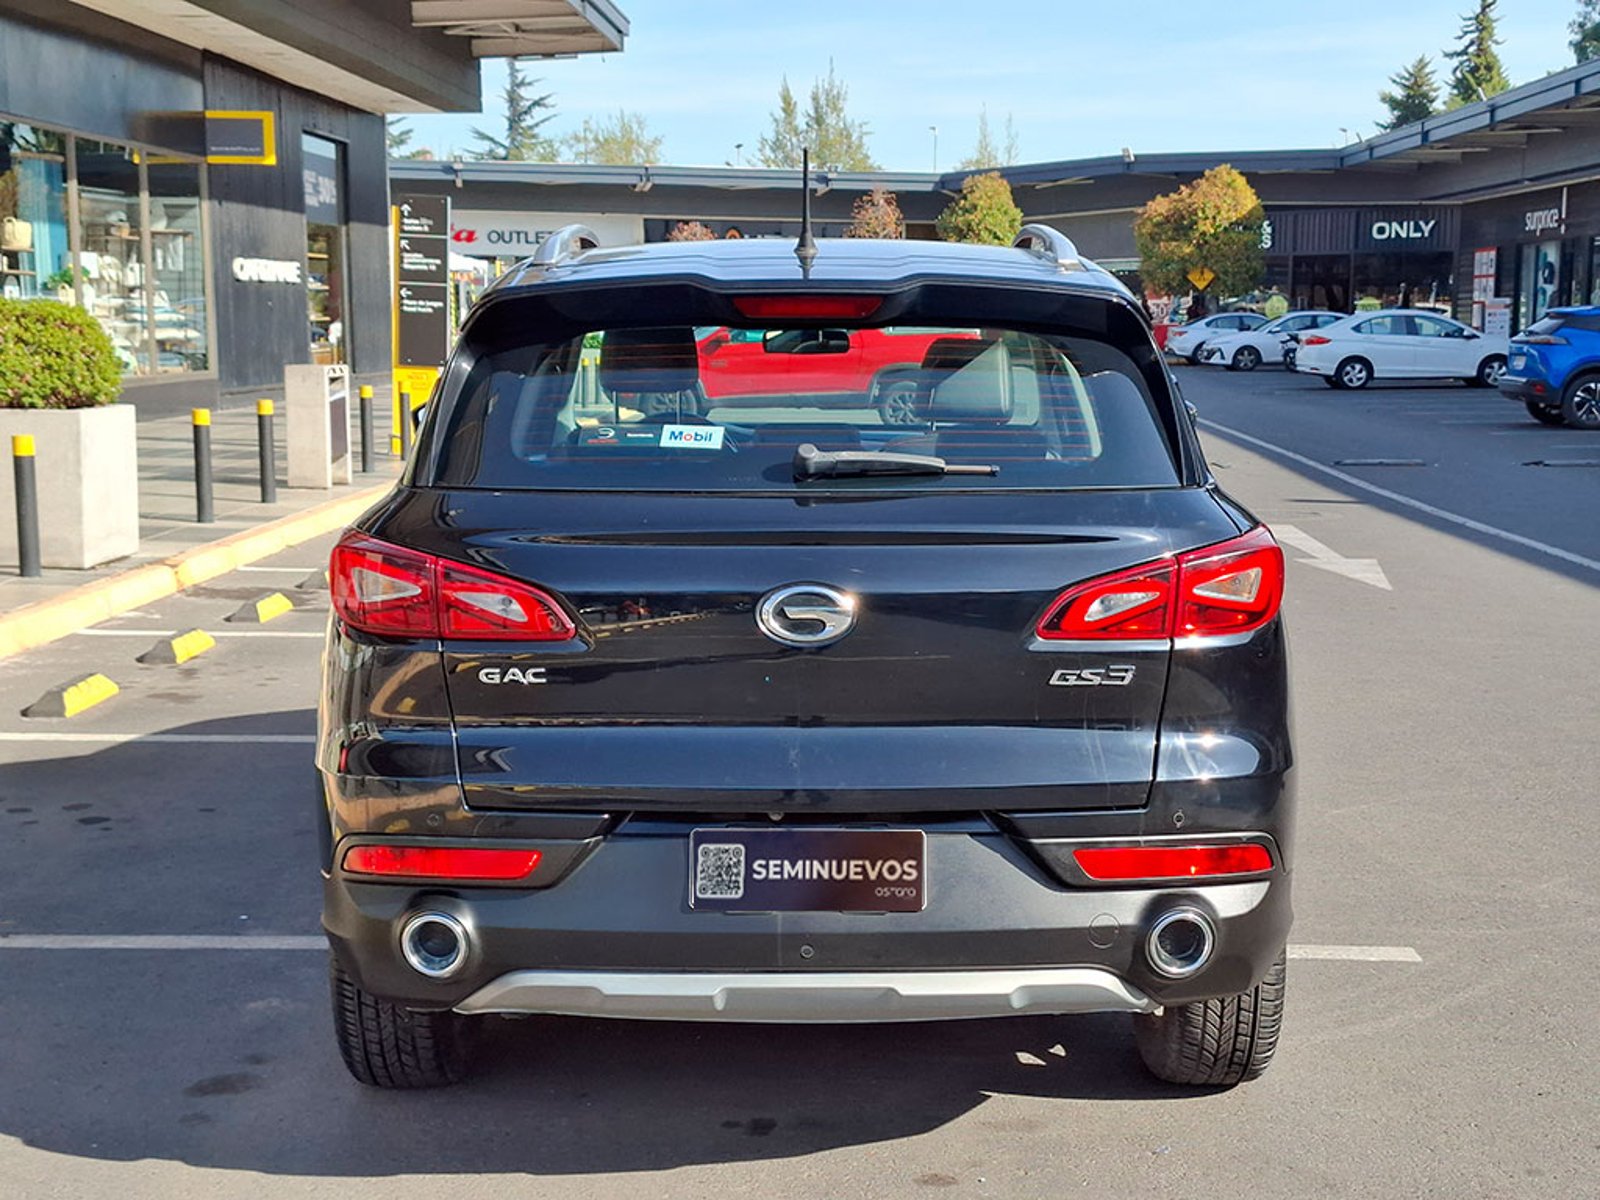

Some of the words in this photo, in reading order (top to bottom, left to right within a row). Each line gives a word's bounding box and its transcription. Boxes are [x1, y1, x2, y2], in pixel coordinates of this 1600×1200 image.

[1371, 220, 1435, 240] ONLY
[668, 430, 713, 442] Mobil
[478, 667, 548, 685] GAC
[1049, 665, 1136, 685] GS3
[752, 859, 918, 881] SEMINUEVOS
